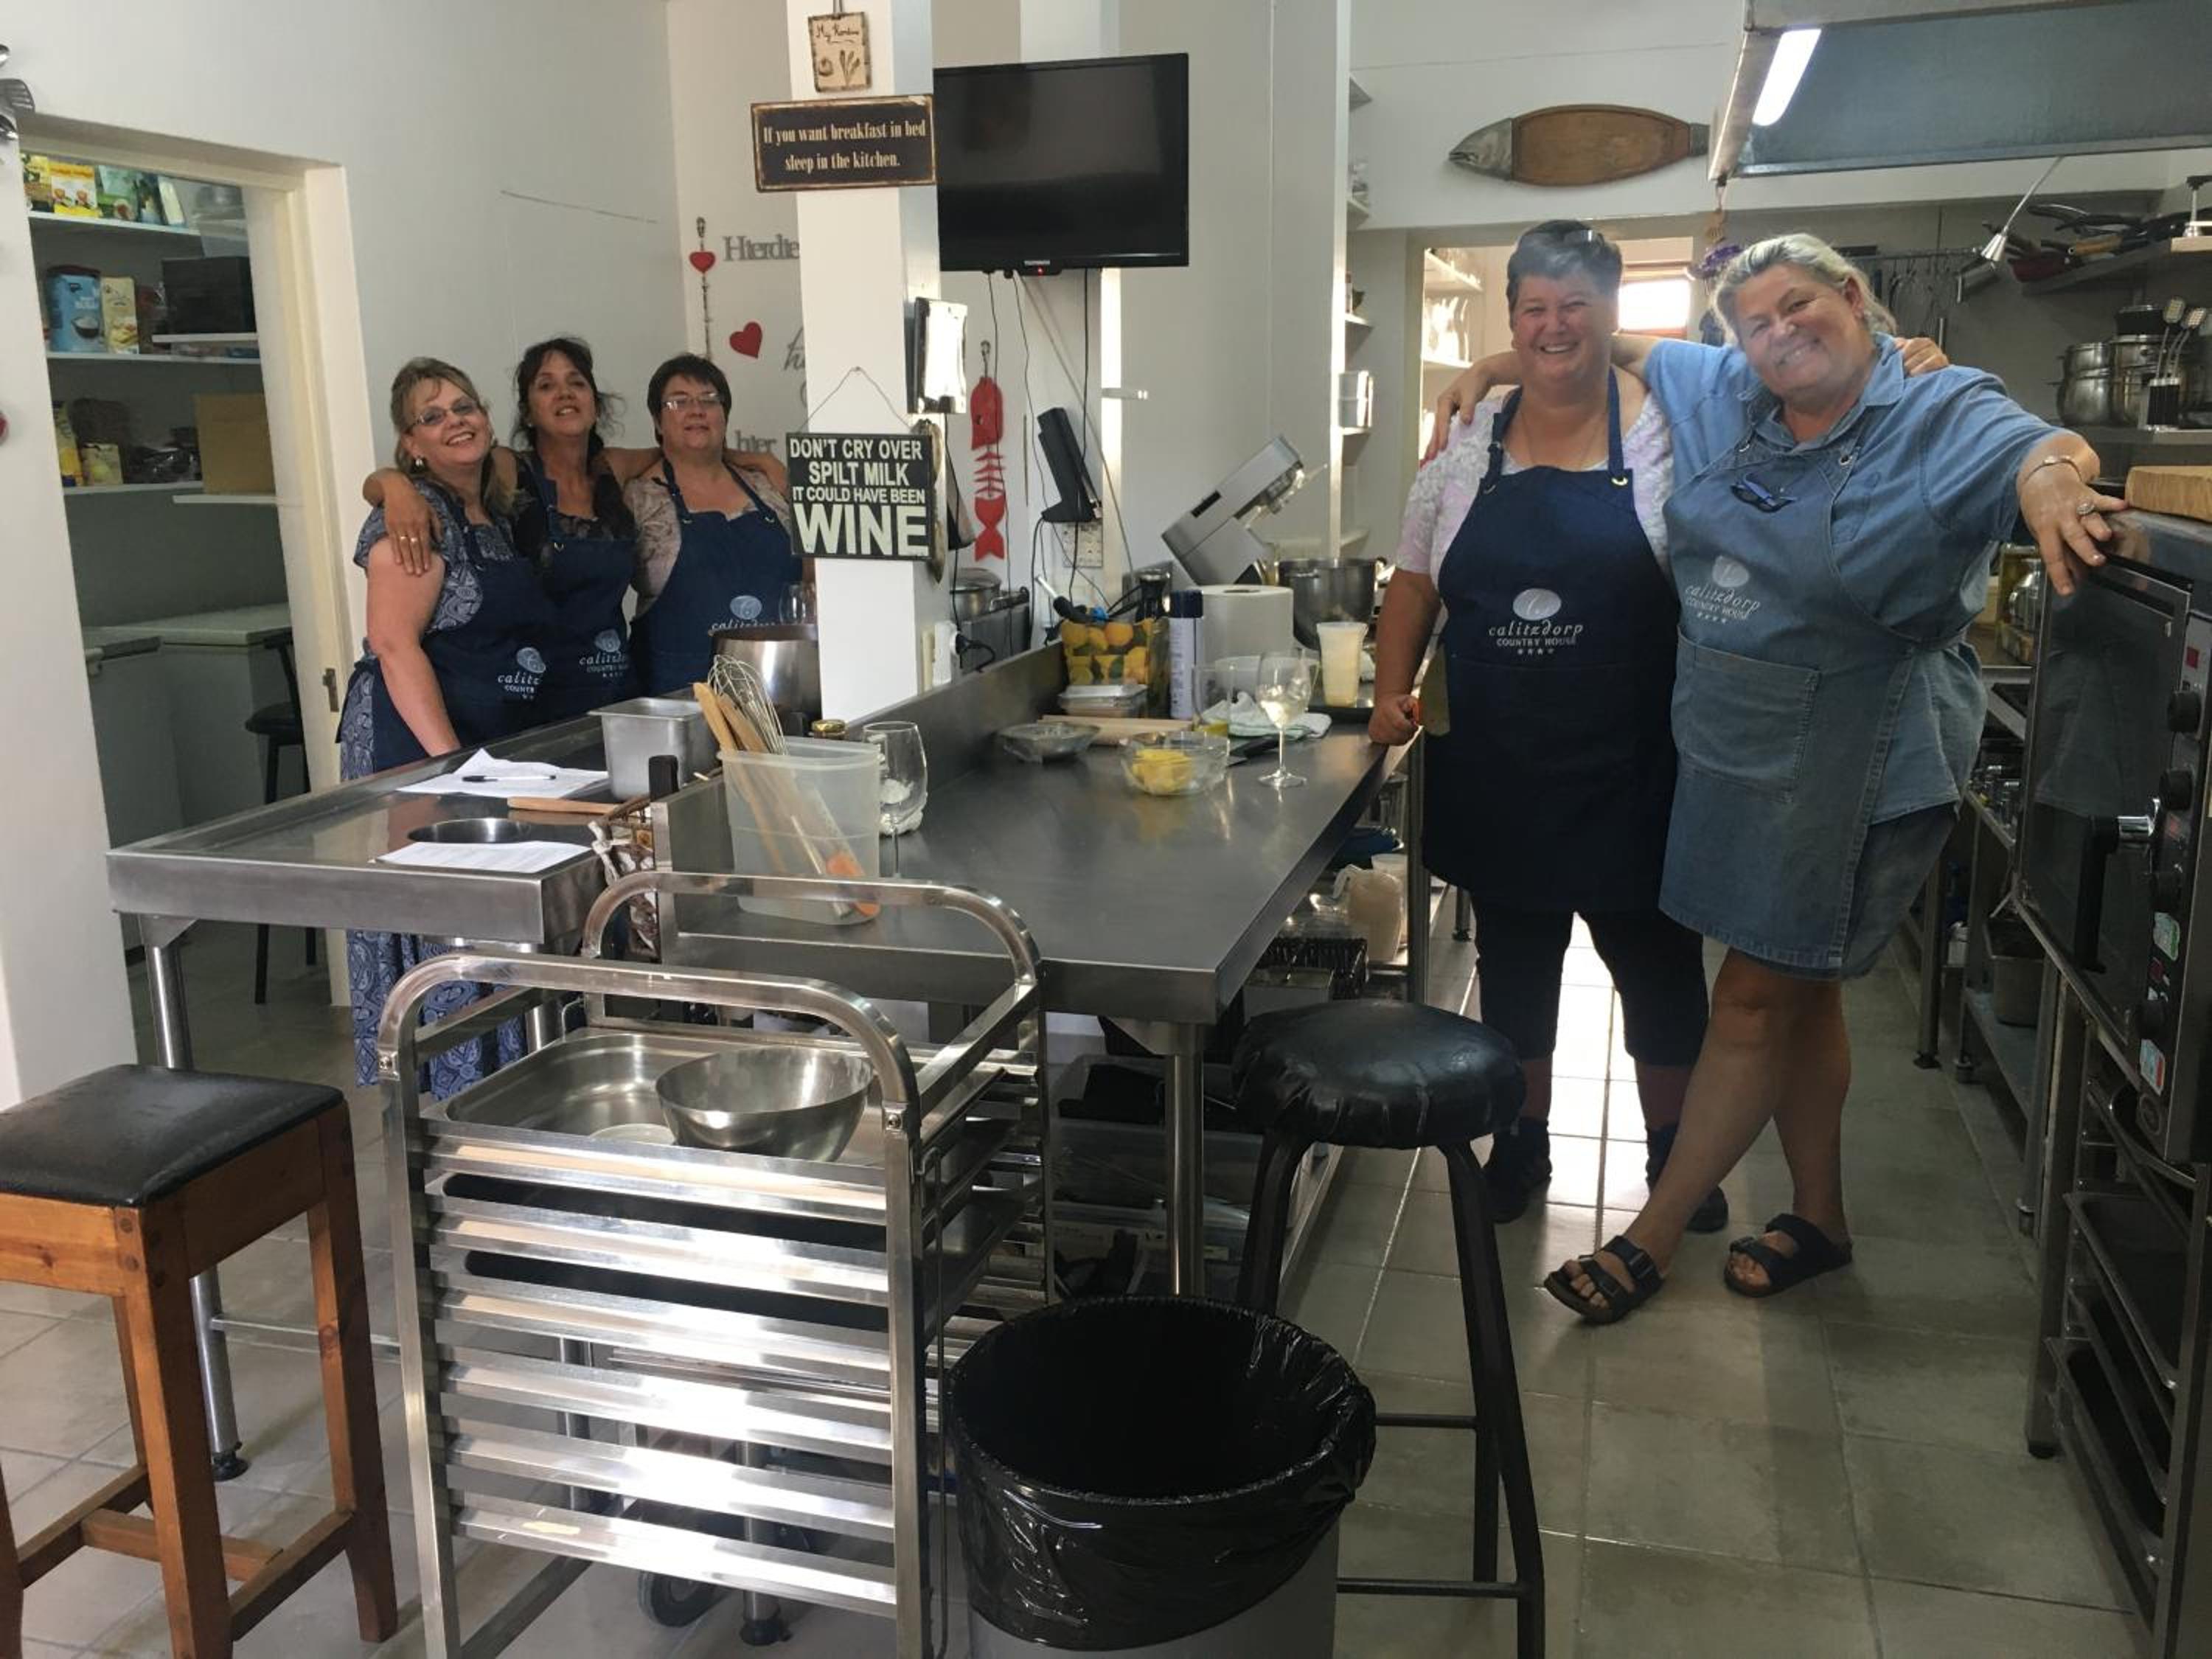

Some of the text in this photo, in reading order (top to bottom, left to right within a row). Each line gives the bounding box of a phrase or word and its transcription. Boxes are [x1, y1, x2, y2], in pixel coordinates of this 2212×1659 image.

[763, 119, 926, 146] If you want breakfast in bed
[785, 150, 901, 174] sleep in the kitchen.
[790, 438, 923, 460] DON'T CRY OVER
[808, 461, 910, 487] SPILT MILK
[792, 486, 925, 504] IT COULD HAVE BEEN
[793, 502, 930, 557] WINE
[1488, 619, 1585, 637] calitzdorp
[1496, 637, 1541, 647] COUNTRY
